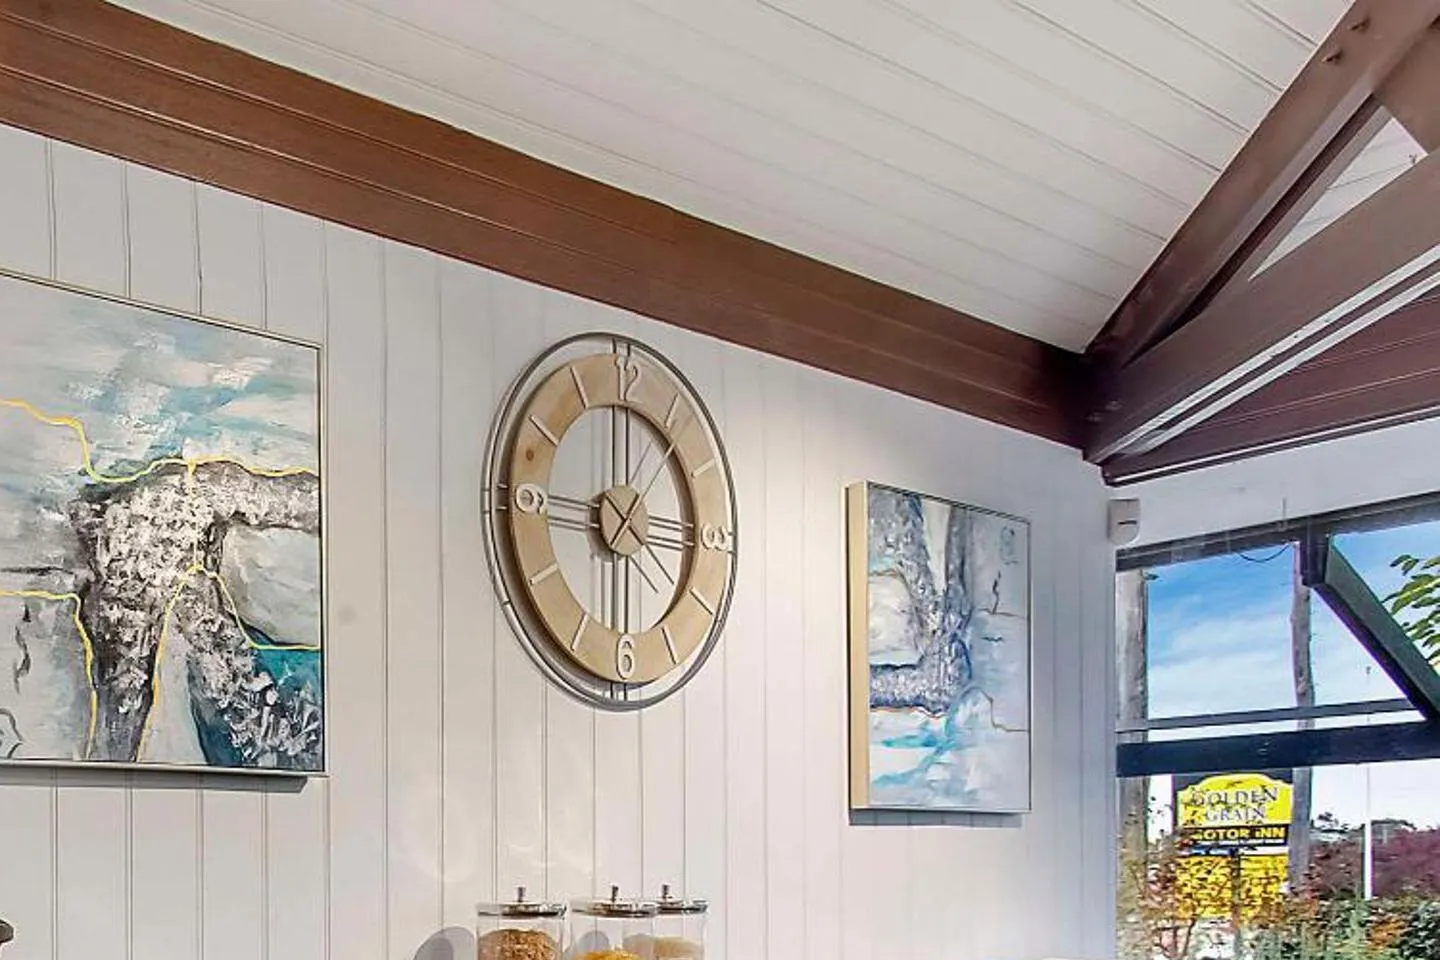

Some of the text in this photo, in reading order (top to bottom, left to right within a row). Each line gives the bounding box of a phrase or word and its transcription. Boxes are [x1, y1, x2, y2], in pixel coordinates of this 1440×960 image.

[614, 356, 640, 401] 12
[515, 483, 548, 515] 9
[615, 633, 638, 680] 6
